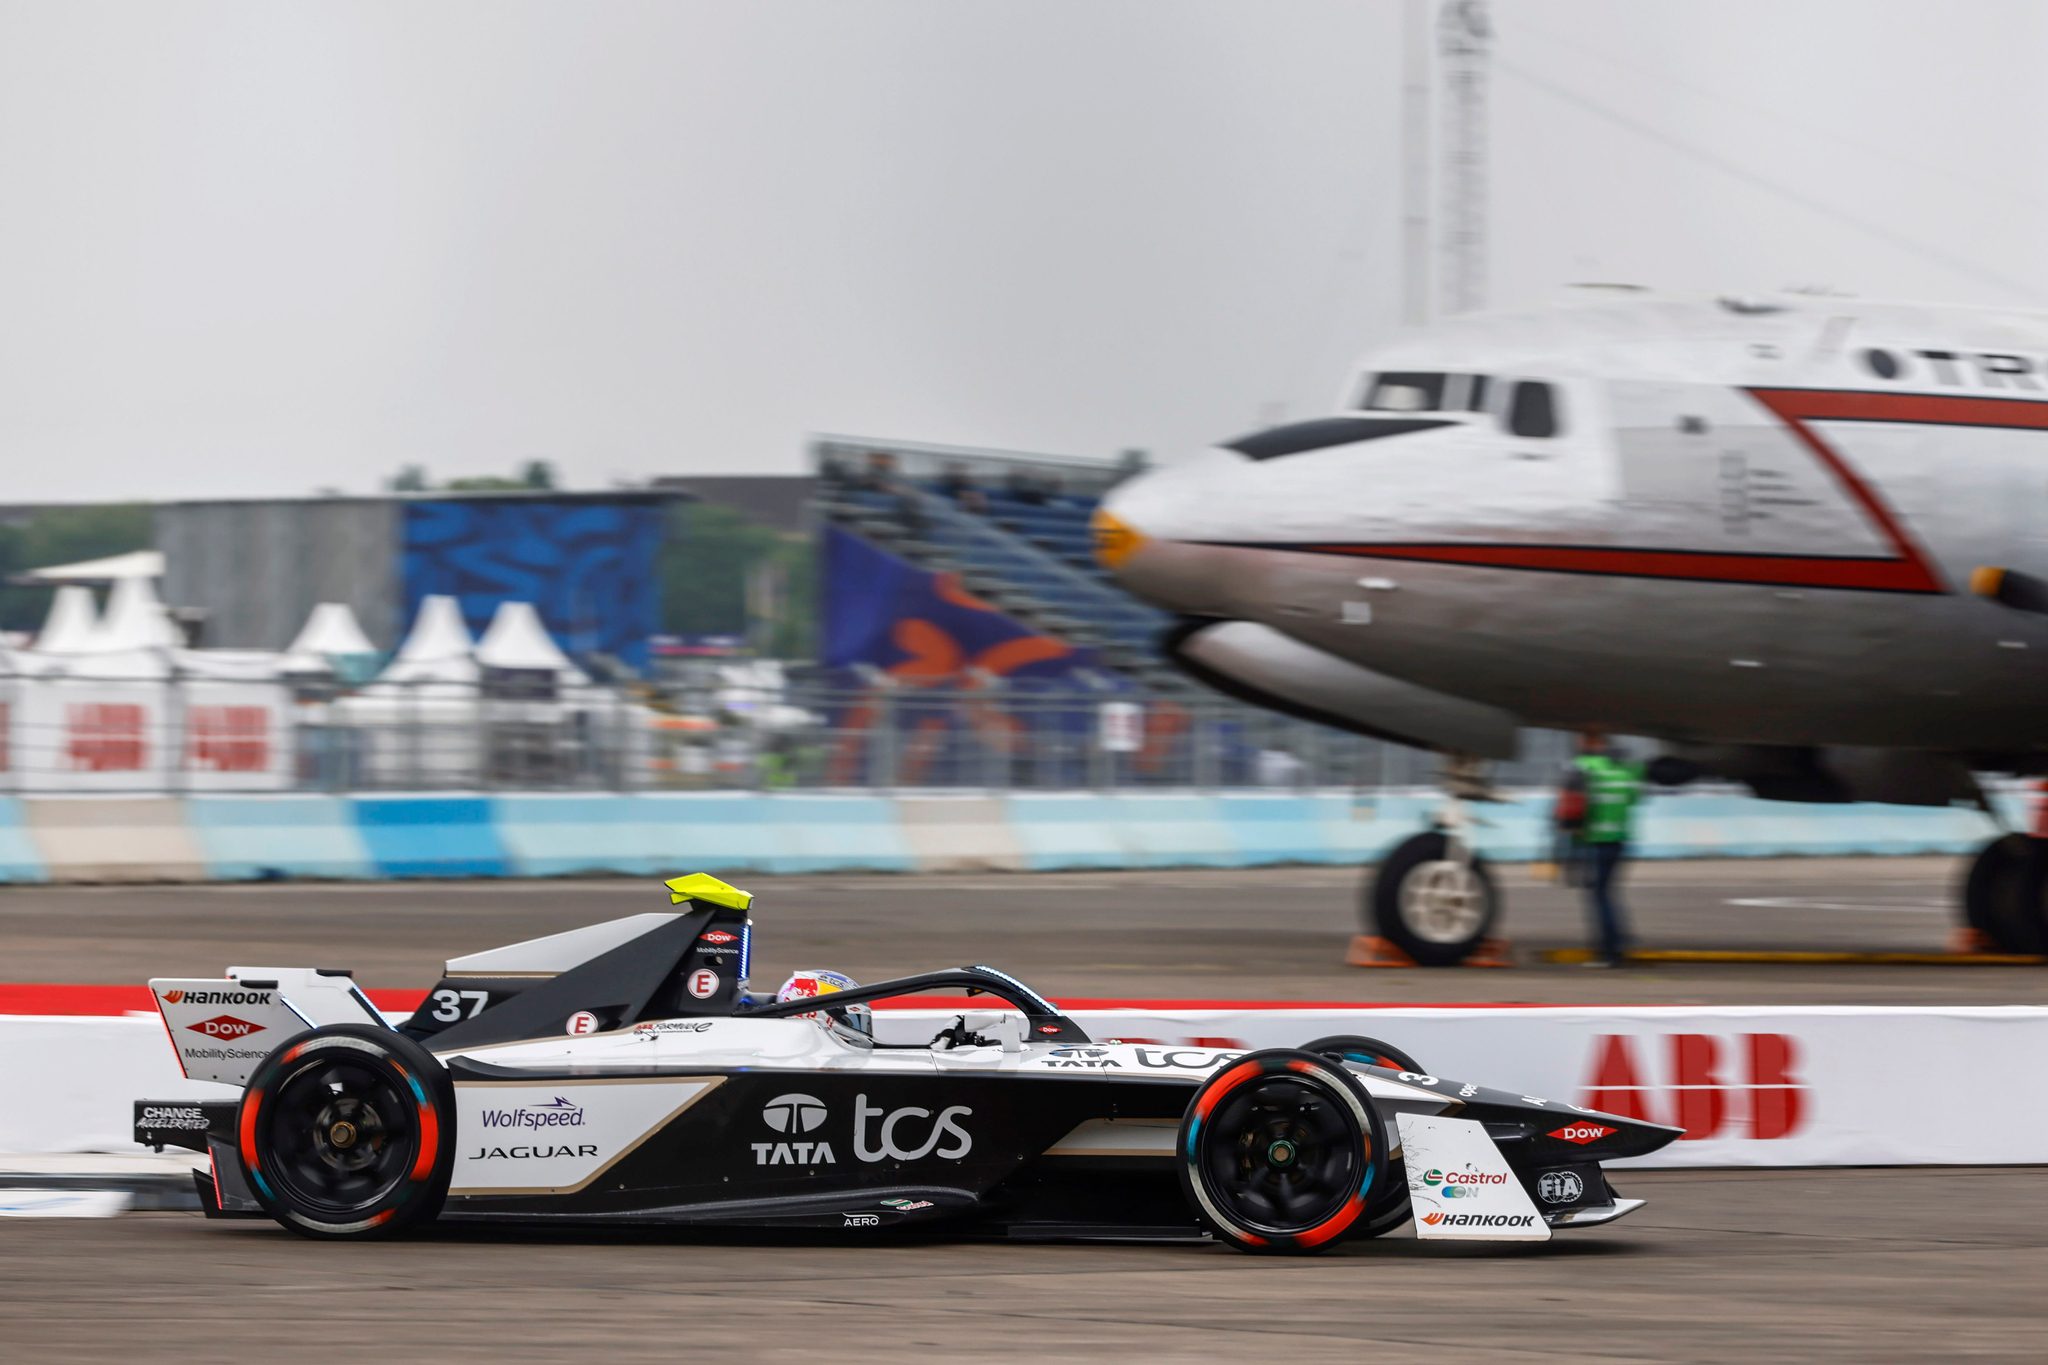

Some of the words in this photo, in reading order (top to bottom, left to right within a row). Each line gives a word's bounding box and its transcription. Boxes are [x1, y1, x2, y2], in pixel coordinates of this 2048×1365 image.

[431, 989, 489, 1022] 37
[204, 1021, 251, 1035] DOW
[184, 1048, 271, 1060] MobilityScience
[1041, 1060, 1123, 1068] TATA
[1574, 1032, 1818, 1141] ABB
[143, 1107, 202, 1119] CHANGE
[482, 1108, 583, 1131] Wolfspeed
[853, 1093, 973, 1163] tcs
[1563, 1127, 1605, 1140] DOW
[468, 1144, 598, 1160] JAGUAR
[751, 1142, 836, 1165] TATA
[1445, 1172, 1508, 1185] Castrol
[843, 1217, 879, 1227] AERO
